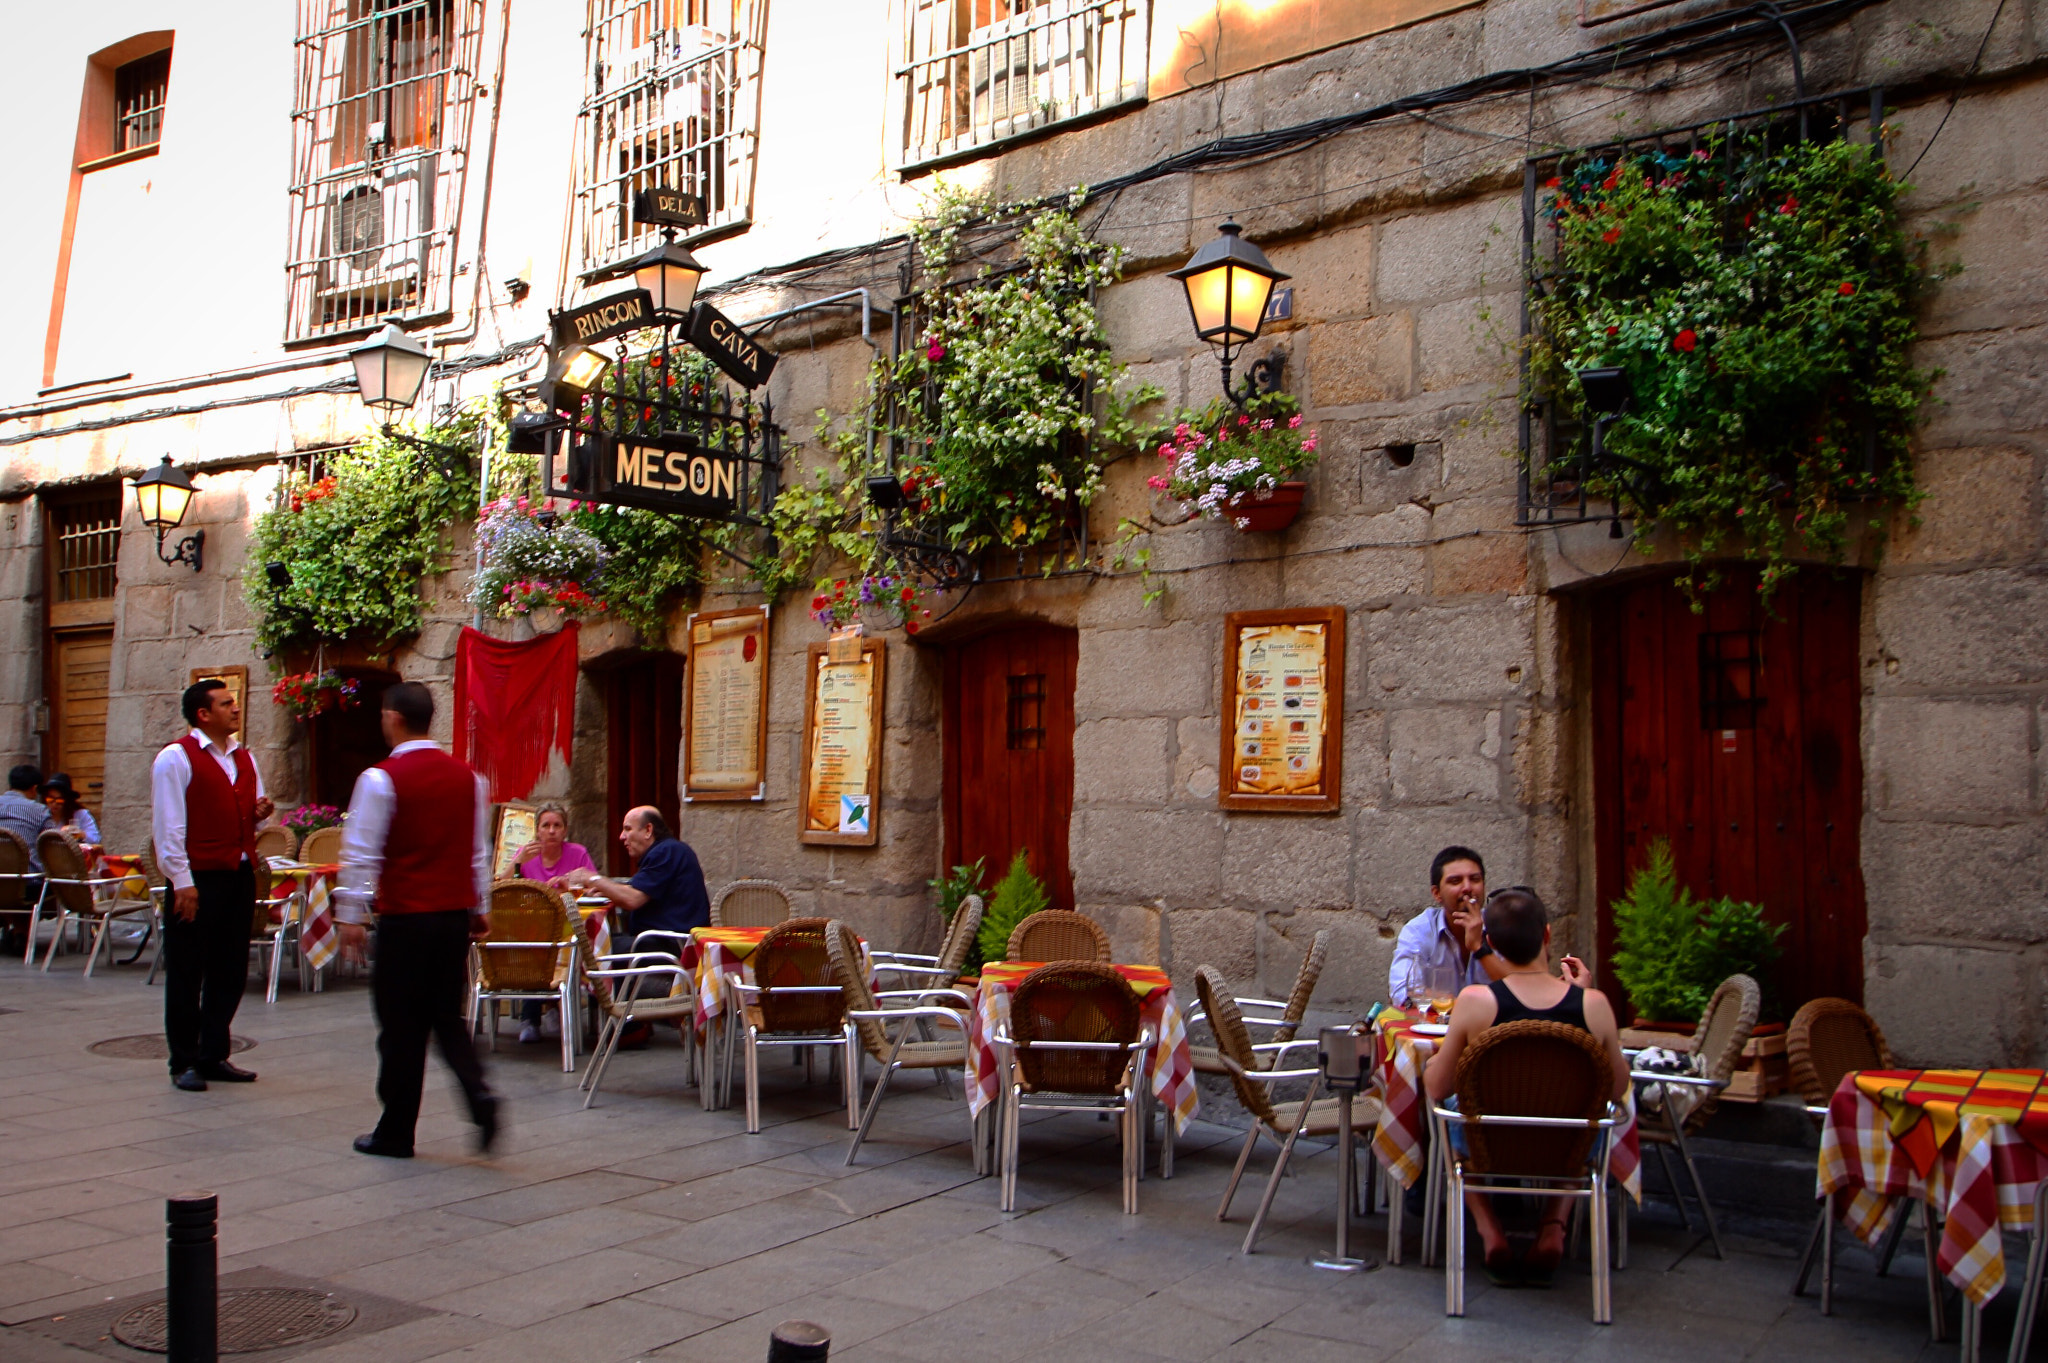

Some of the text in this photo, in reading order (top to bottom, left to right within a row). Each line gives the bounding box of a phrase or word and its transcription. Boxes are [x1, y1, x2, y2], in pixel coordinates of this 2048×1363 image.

[658, 196, 696, 217] DE LA
[575, 298, 642, 339] RINCON
[710, 320, 758, 372] CAVA
[616, 443, 735, 500] MESON
[5, 514, 17, 531] 15
